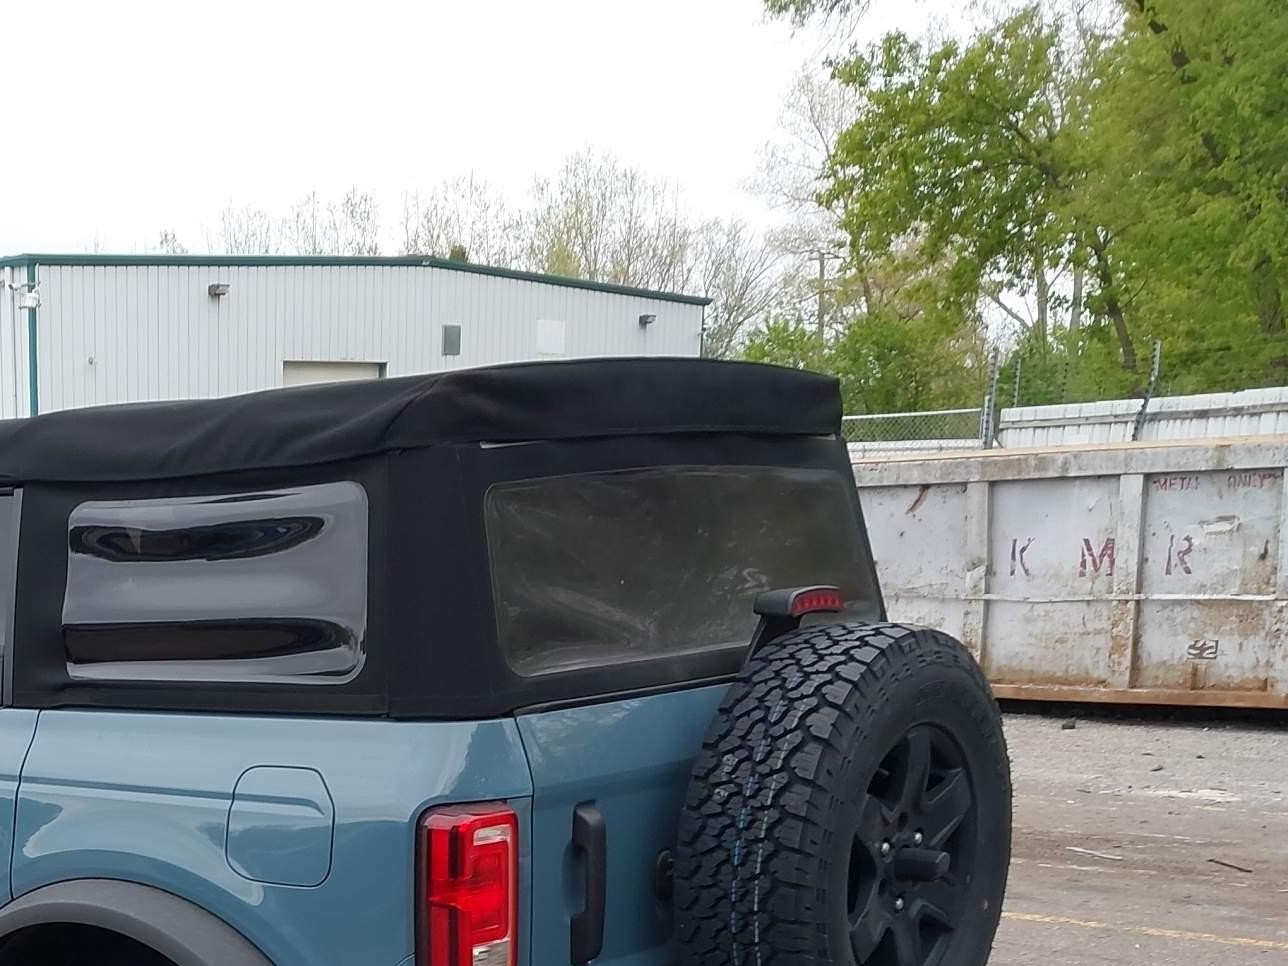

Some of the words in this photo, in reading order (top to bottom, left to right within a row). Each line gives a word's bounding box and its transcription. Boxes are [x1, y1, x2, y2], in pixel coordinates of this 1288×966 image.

[1009, 536, 1035, 577] K
[1078, 537, 1116, 578] M
[1164, 534, 1193, 576] R
